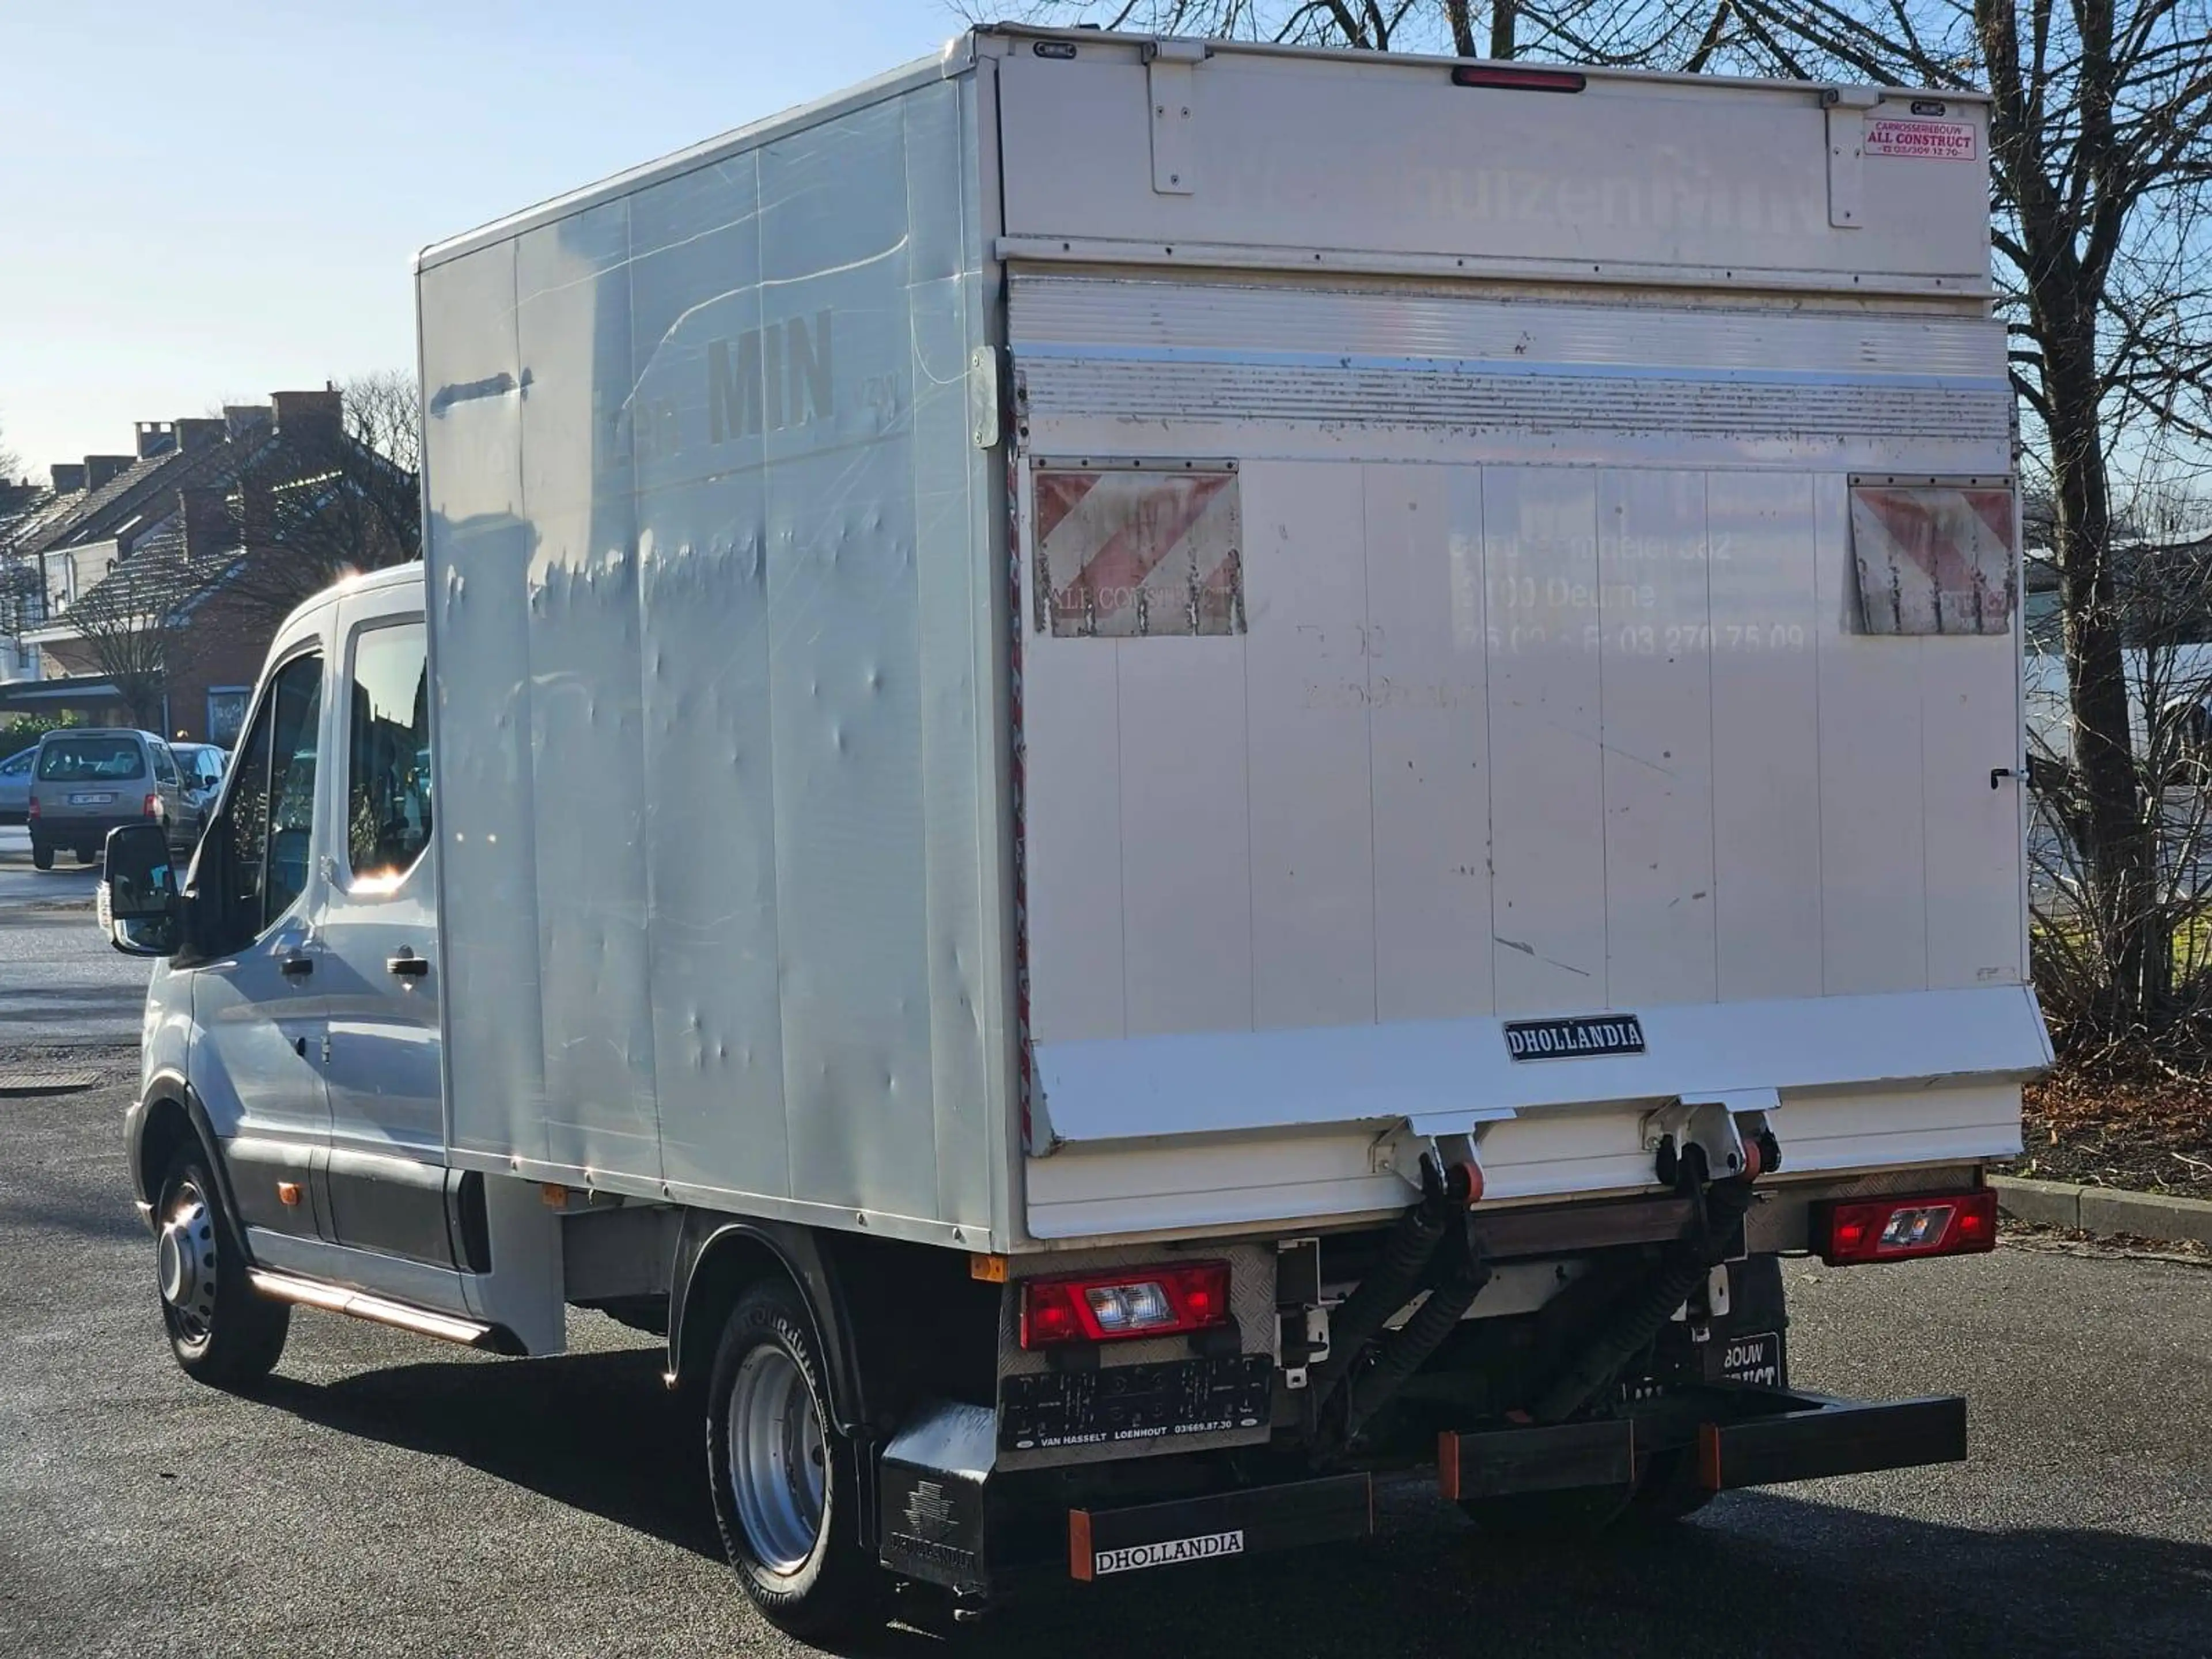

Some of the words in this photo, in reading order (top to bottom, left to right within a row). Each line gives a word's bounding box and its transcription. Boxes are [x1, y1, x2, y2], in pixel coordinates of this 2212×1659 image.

[1868, 131, 1893, 144] ALL
[1896, 133, 1971, 149] CONSTRUCT
[707, 309, 833, 444] MIN
[1620, 624, 1656, 654] 03
[1508, 1023, 1643, 1054] DHOLLANDIA
[1041, 1437, 1061, 1447] VAN
[1063, 1433, 1107, 1445] HASSELT
[1115, 1426, 1168, 1440] LOENHOUT
[1098, 1533, 1241, 1571] DHOLLANDIA
